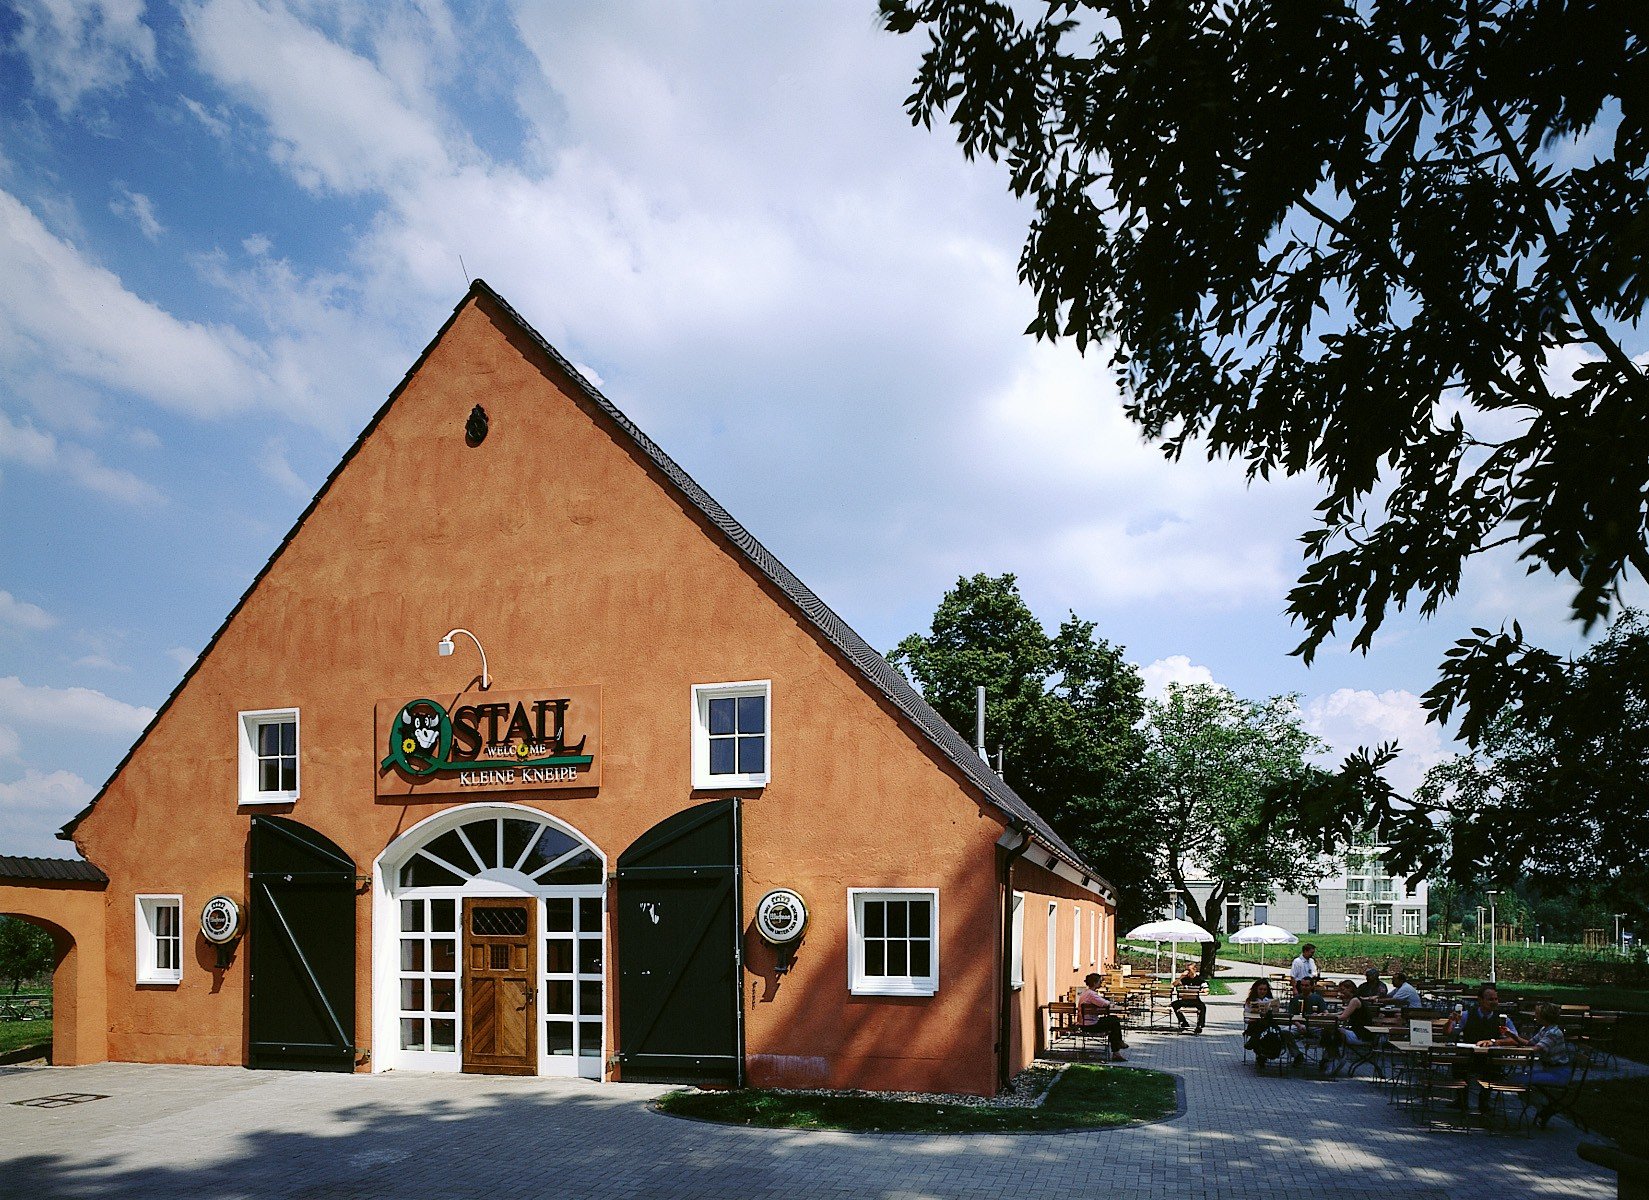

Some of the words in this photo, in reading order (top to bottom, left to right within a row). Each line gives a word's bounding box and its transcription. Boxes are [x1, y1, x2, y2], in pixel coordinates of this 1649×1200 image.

[487, 743, 547, 757] WELCOME
[460, 769, 515, 785] KLEINE
[522, 766, 578, 783] KNEIPE
